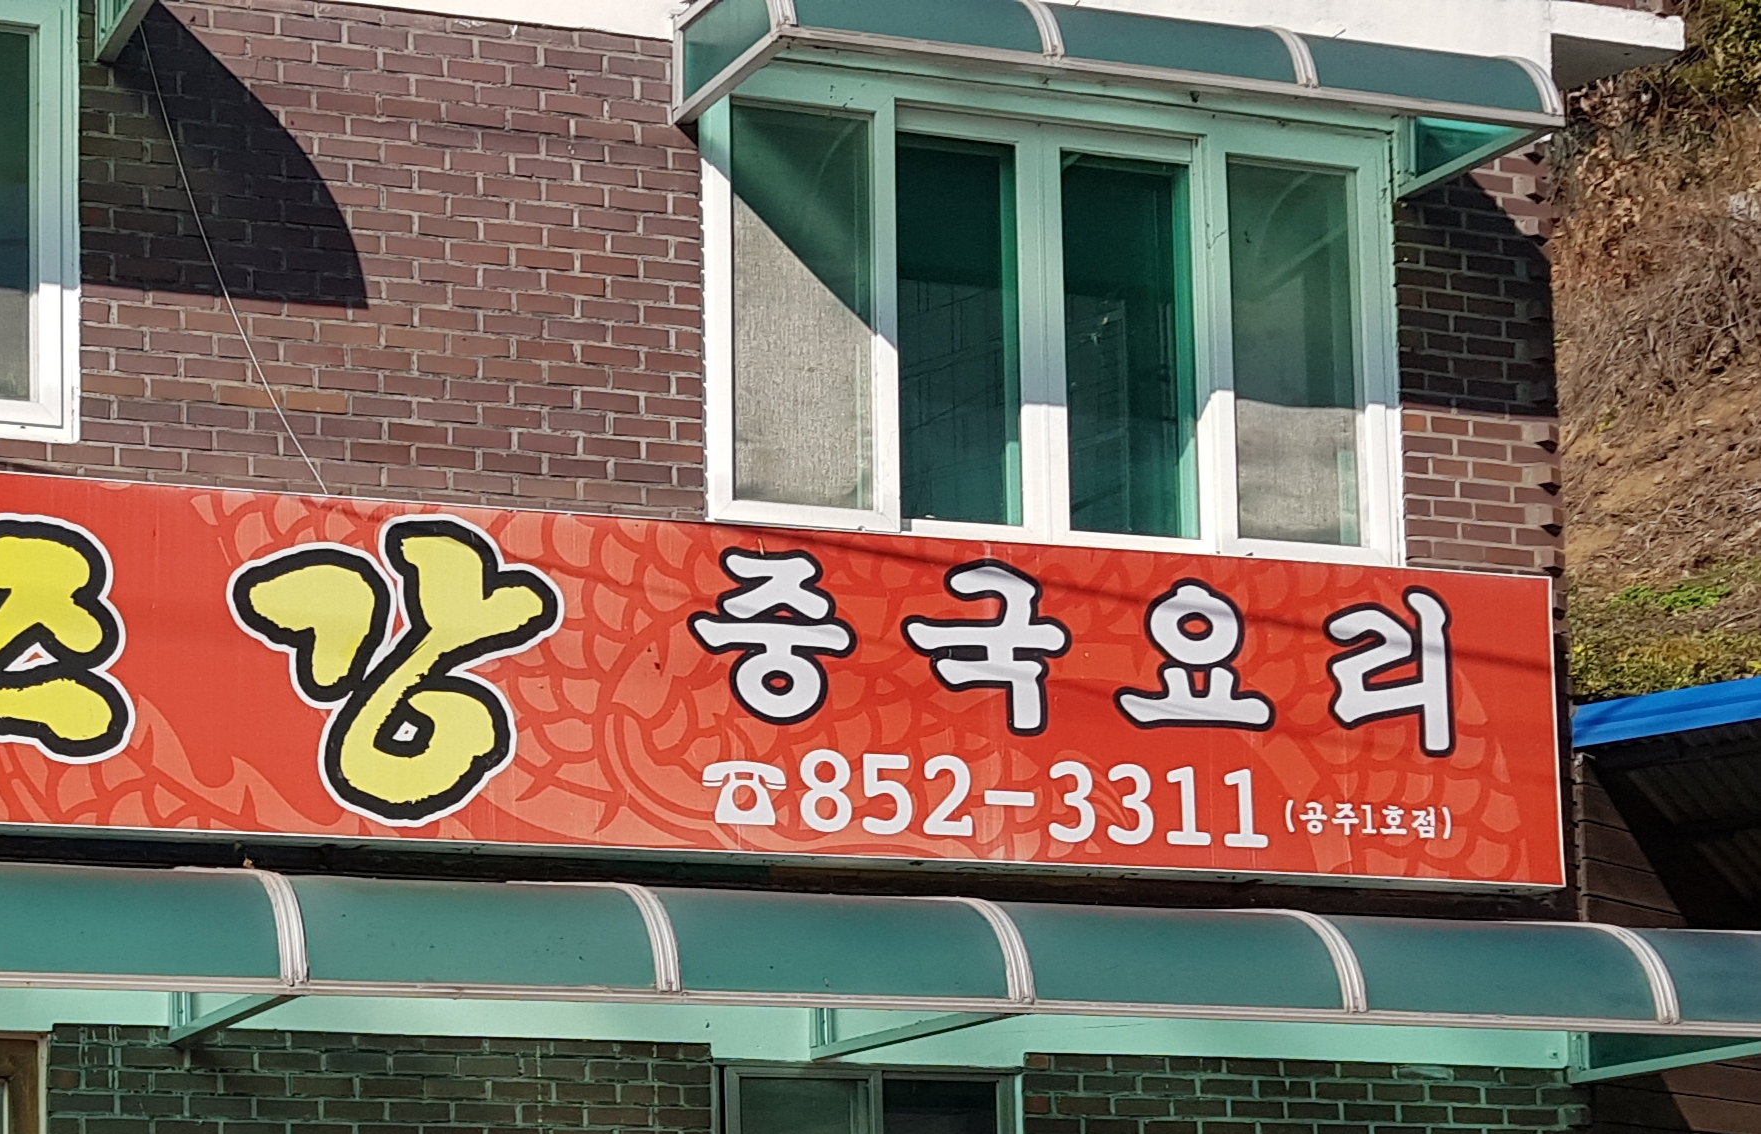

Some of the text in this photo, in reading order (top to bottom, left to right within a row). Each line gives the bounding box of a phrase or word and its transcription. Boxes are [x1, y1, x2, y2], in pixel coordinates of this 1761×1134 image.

[687, 547, 1456, 758] 중국요리
[800, 748, 1270, 850] 852-3311
[1284, 799, 1452, 839] (공주1호점)
